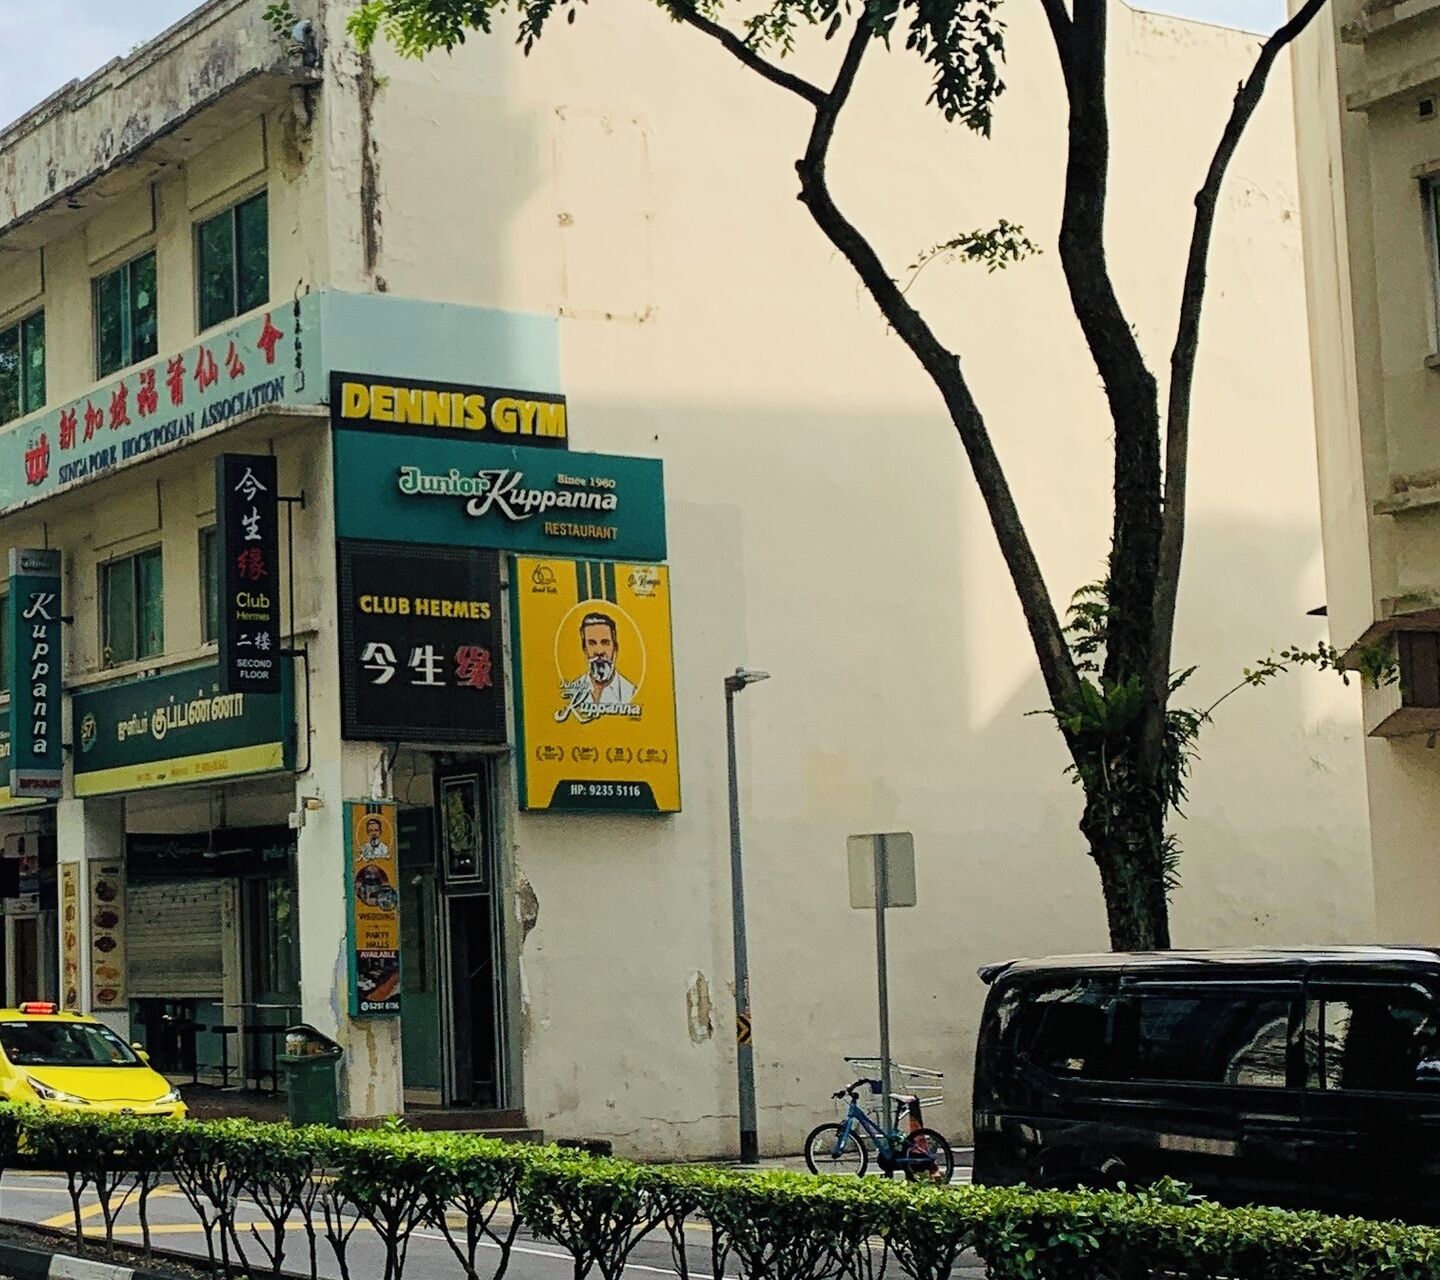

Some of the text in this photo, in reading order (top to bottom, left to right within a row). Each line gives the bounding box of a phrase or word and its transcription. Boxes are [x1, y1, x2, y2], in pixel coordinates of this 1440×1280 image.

[341, 382, 567, 438] DENNIS GYM
[59, 444, 117, 485] SINGAPORE
[201, 375, 285, 430] ASSOCIATION
[557, 473, 617, 489] Since 1960
[398, 466, 618, 521] Junior Kuppanna
[544, 521, 619, 540] RESTAURANT
[236, 591, 270, 609] Club
[359, 594, 492, 620] CLUB HERMES
[21, 591, 56, 754] Kuppanna
[236, 659, 272, 669] SECOND
[239, 669, 270, 680] FLOOR
[553, 689, 643, 724] Kuppanna
[570, 784, 641, 797] HP: 9235 5116
[358, 912, 396, 921] WEDDING
[366, 931, 390, 939] PARTY
[361, 951, 397, 959] AVAILABLE
